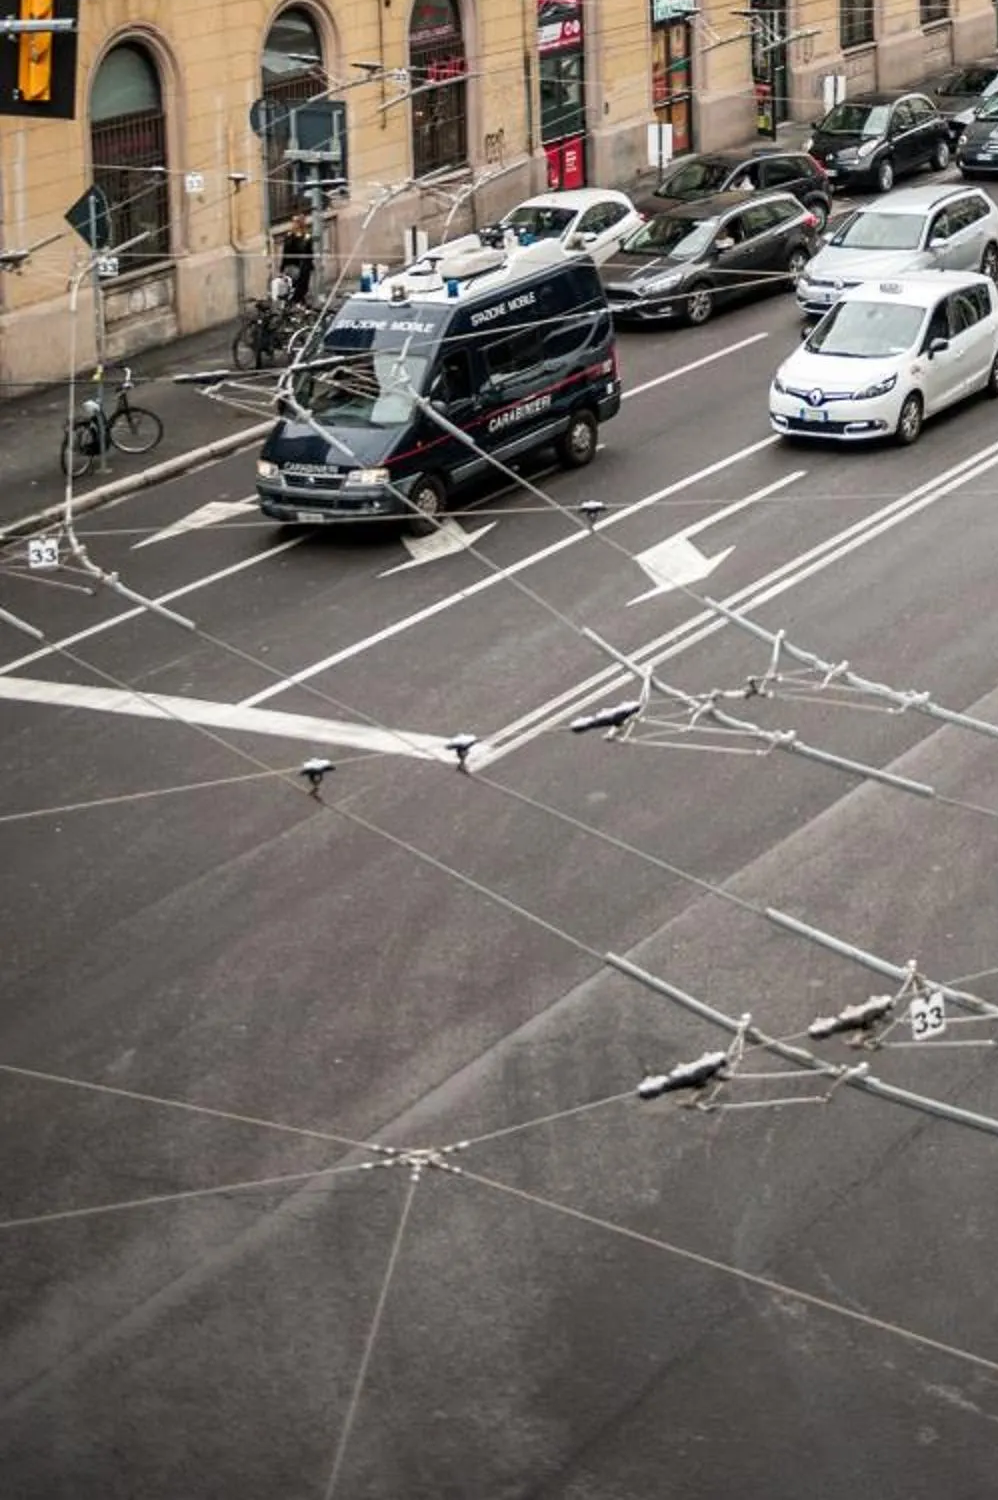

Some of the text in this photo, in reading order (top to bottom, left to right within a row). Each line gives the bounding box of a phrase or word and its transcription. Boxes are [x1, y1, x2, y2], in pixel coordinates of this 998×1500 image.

[470, 291, 537, 327] STAZIONE MOBILE
[391, 321, 435, 333] MOBILE
[488, 394, 552, 432] CARABINIERI
[31, 547, 57, 563] 33
[914, 1006, 943, 1033] 33
